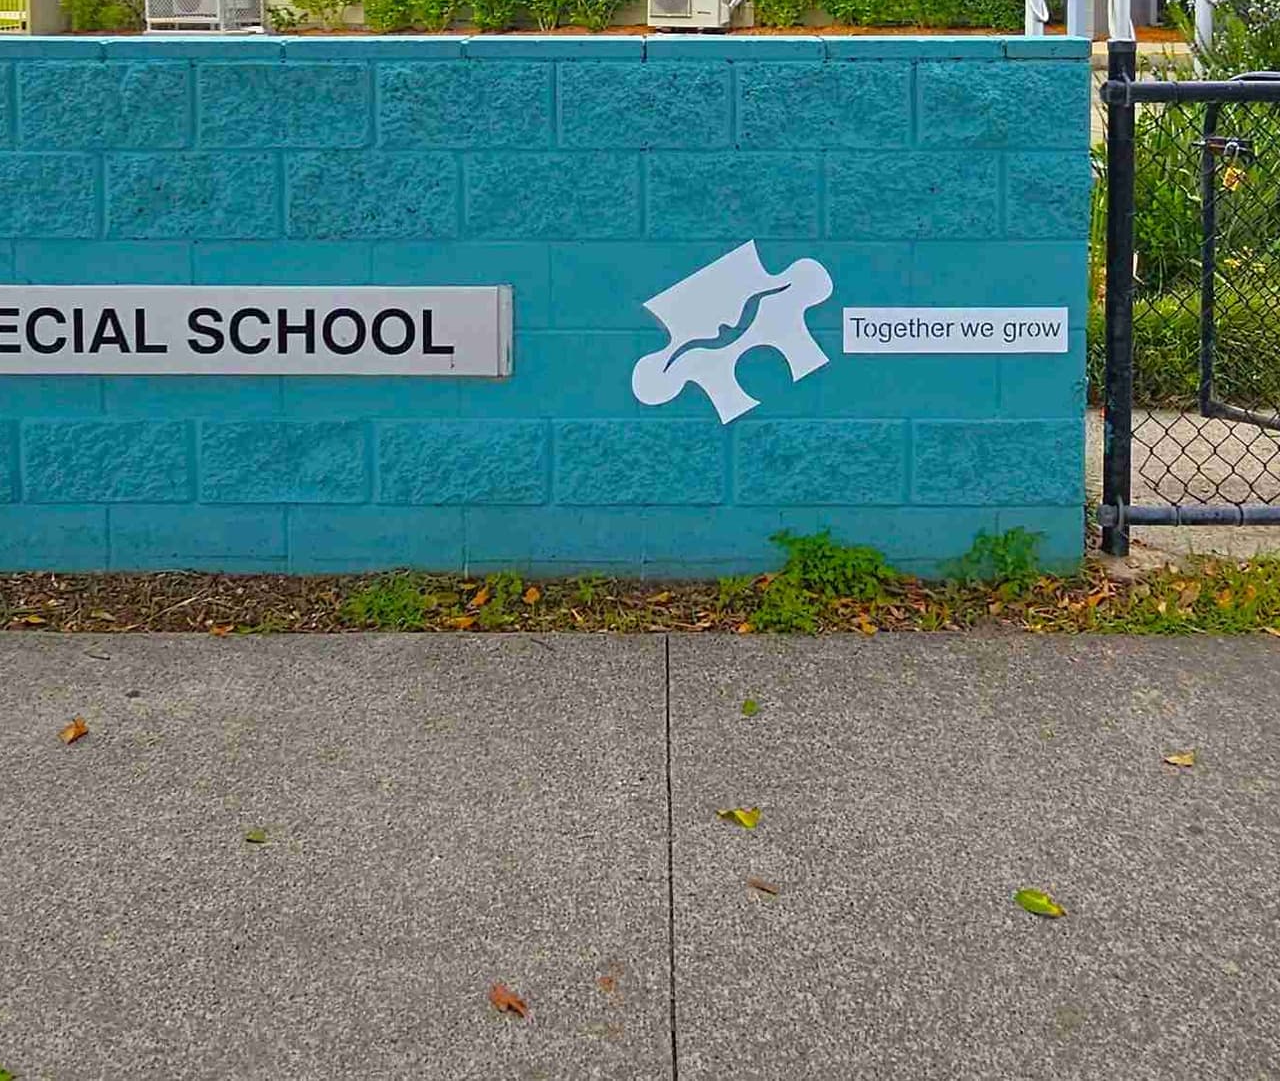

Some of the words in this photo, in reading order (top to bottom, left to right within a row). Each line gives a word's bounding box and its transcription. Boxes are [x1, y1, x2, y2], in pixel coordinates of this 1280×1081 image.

[187, 307, 455, 356] SCHOOL
[850, 317, 955, 343] Together
[960, 322, 994, 337] we
[1003, 322, 1061, 343] grow
